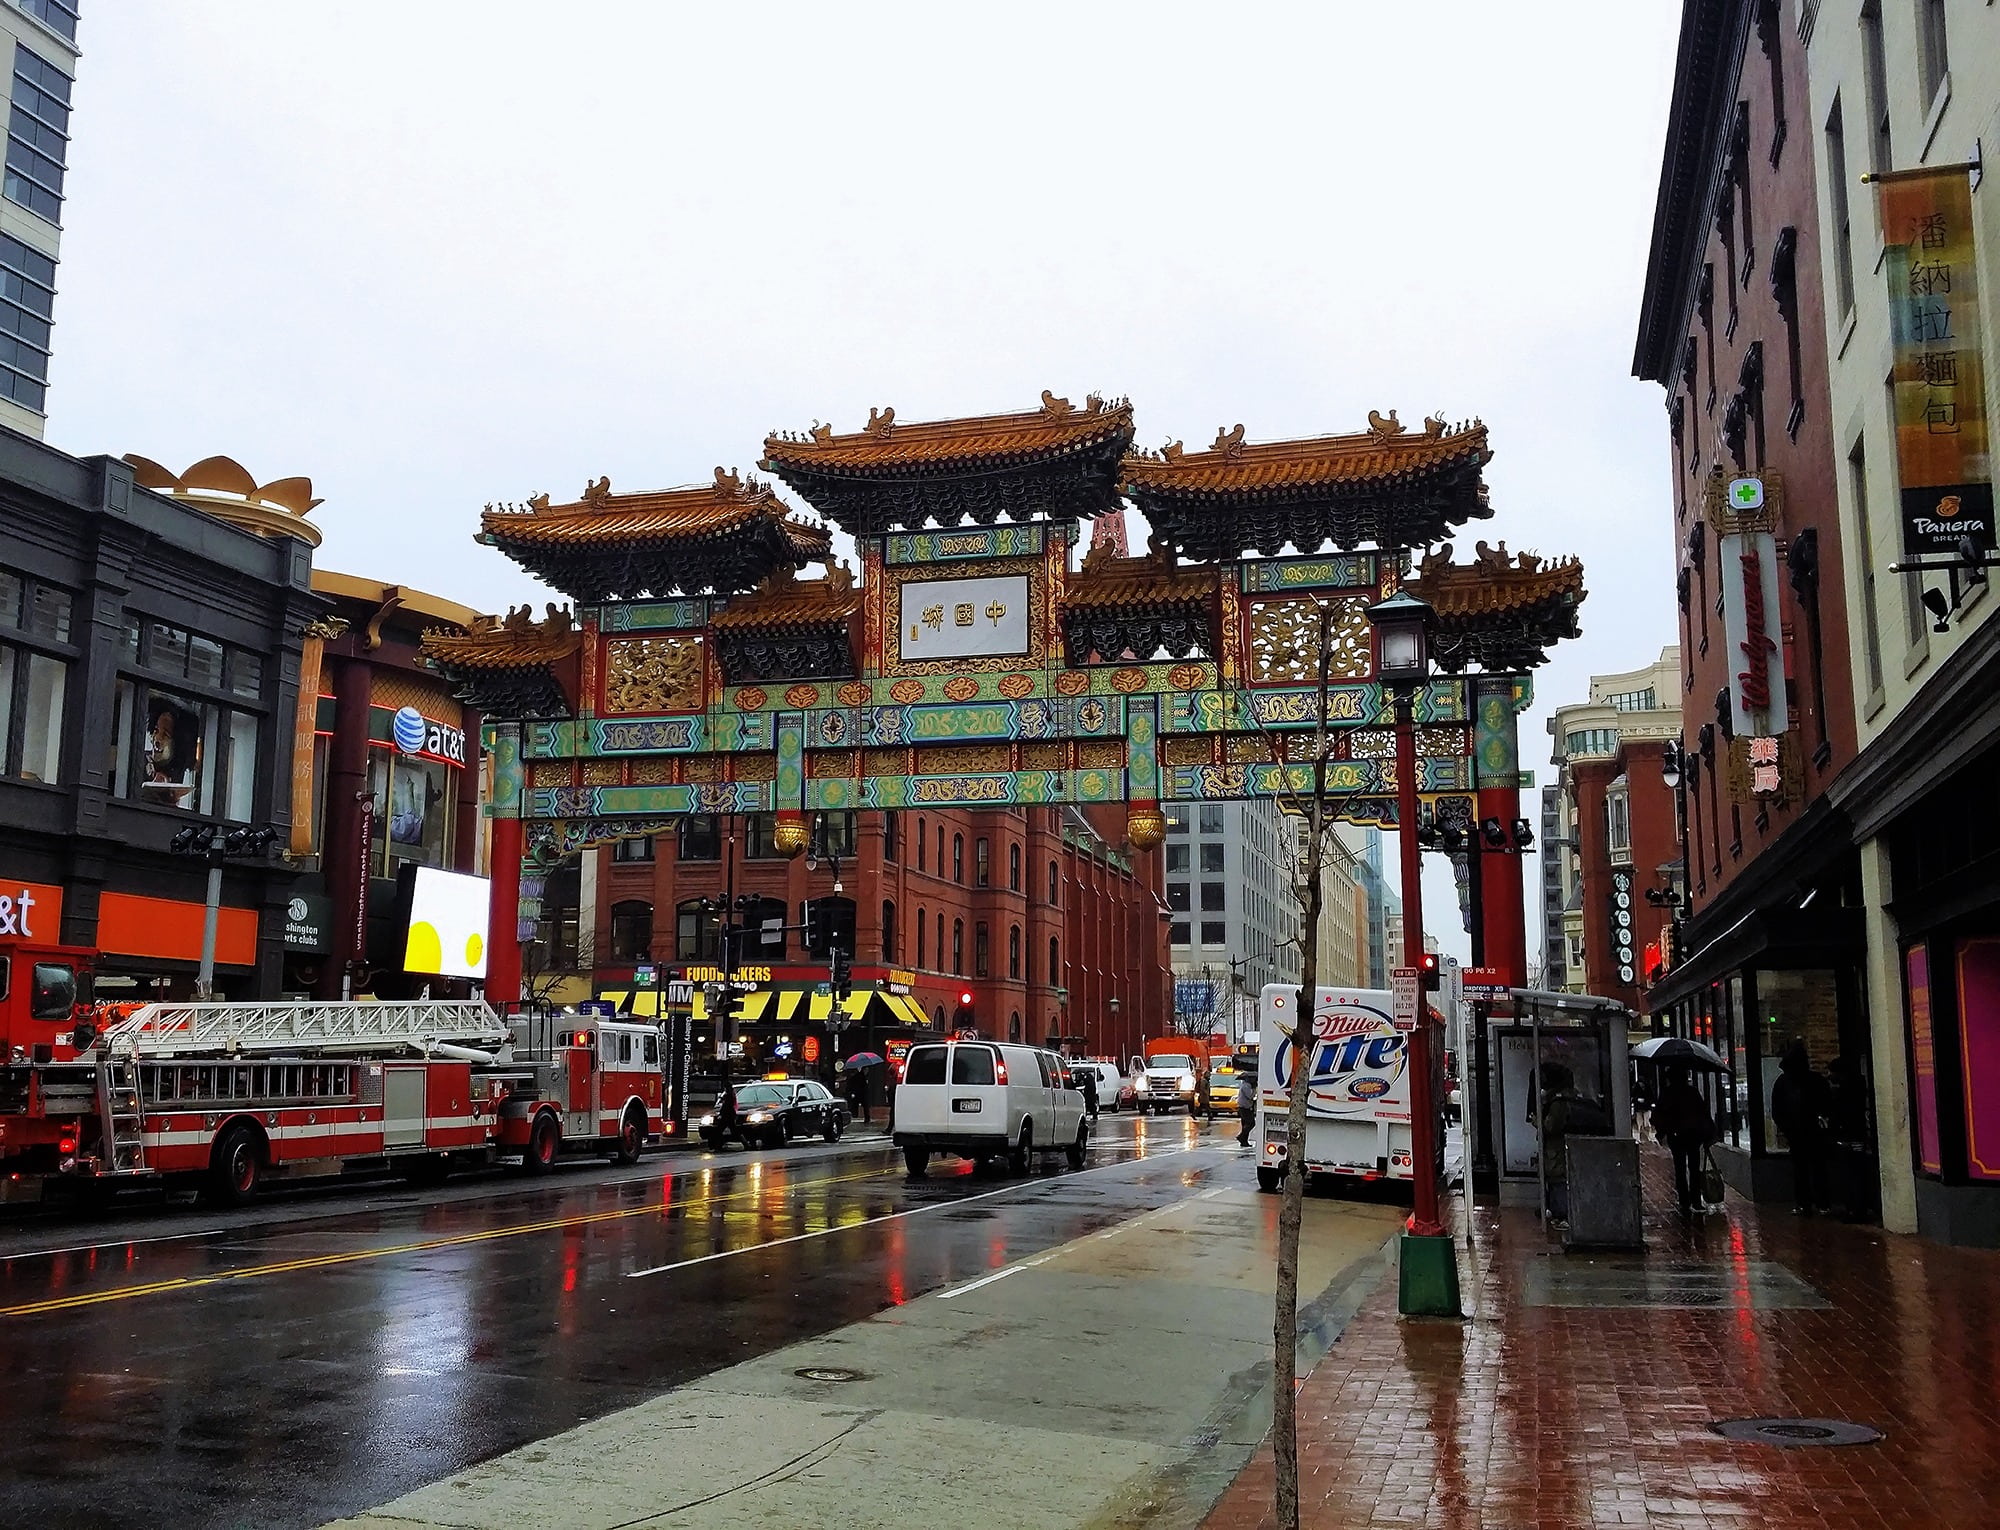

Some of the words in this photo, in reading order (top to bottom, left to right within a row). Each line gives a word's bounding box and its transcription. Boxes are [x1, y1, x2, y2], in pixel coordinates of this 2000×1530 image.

[1909, 212, 1960, 434] 潘納拉麵包
[1912, 518, 1984, 534] Panera
[1932, 534, 1969, 542] BREAD
[427, 724, 466, 763] at&t
[285, 922, 318, 935] shington
[299, 934, 318, 946] clubs
[686, 966, 772, 982] FUDDRCKERS
[685, 1016, 693, 1042] Gallery
[1313, 1014, 1387, 1039] Miller
[681, 1094, 689, 1121] Station
